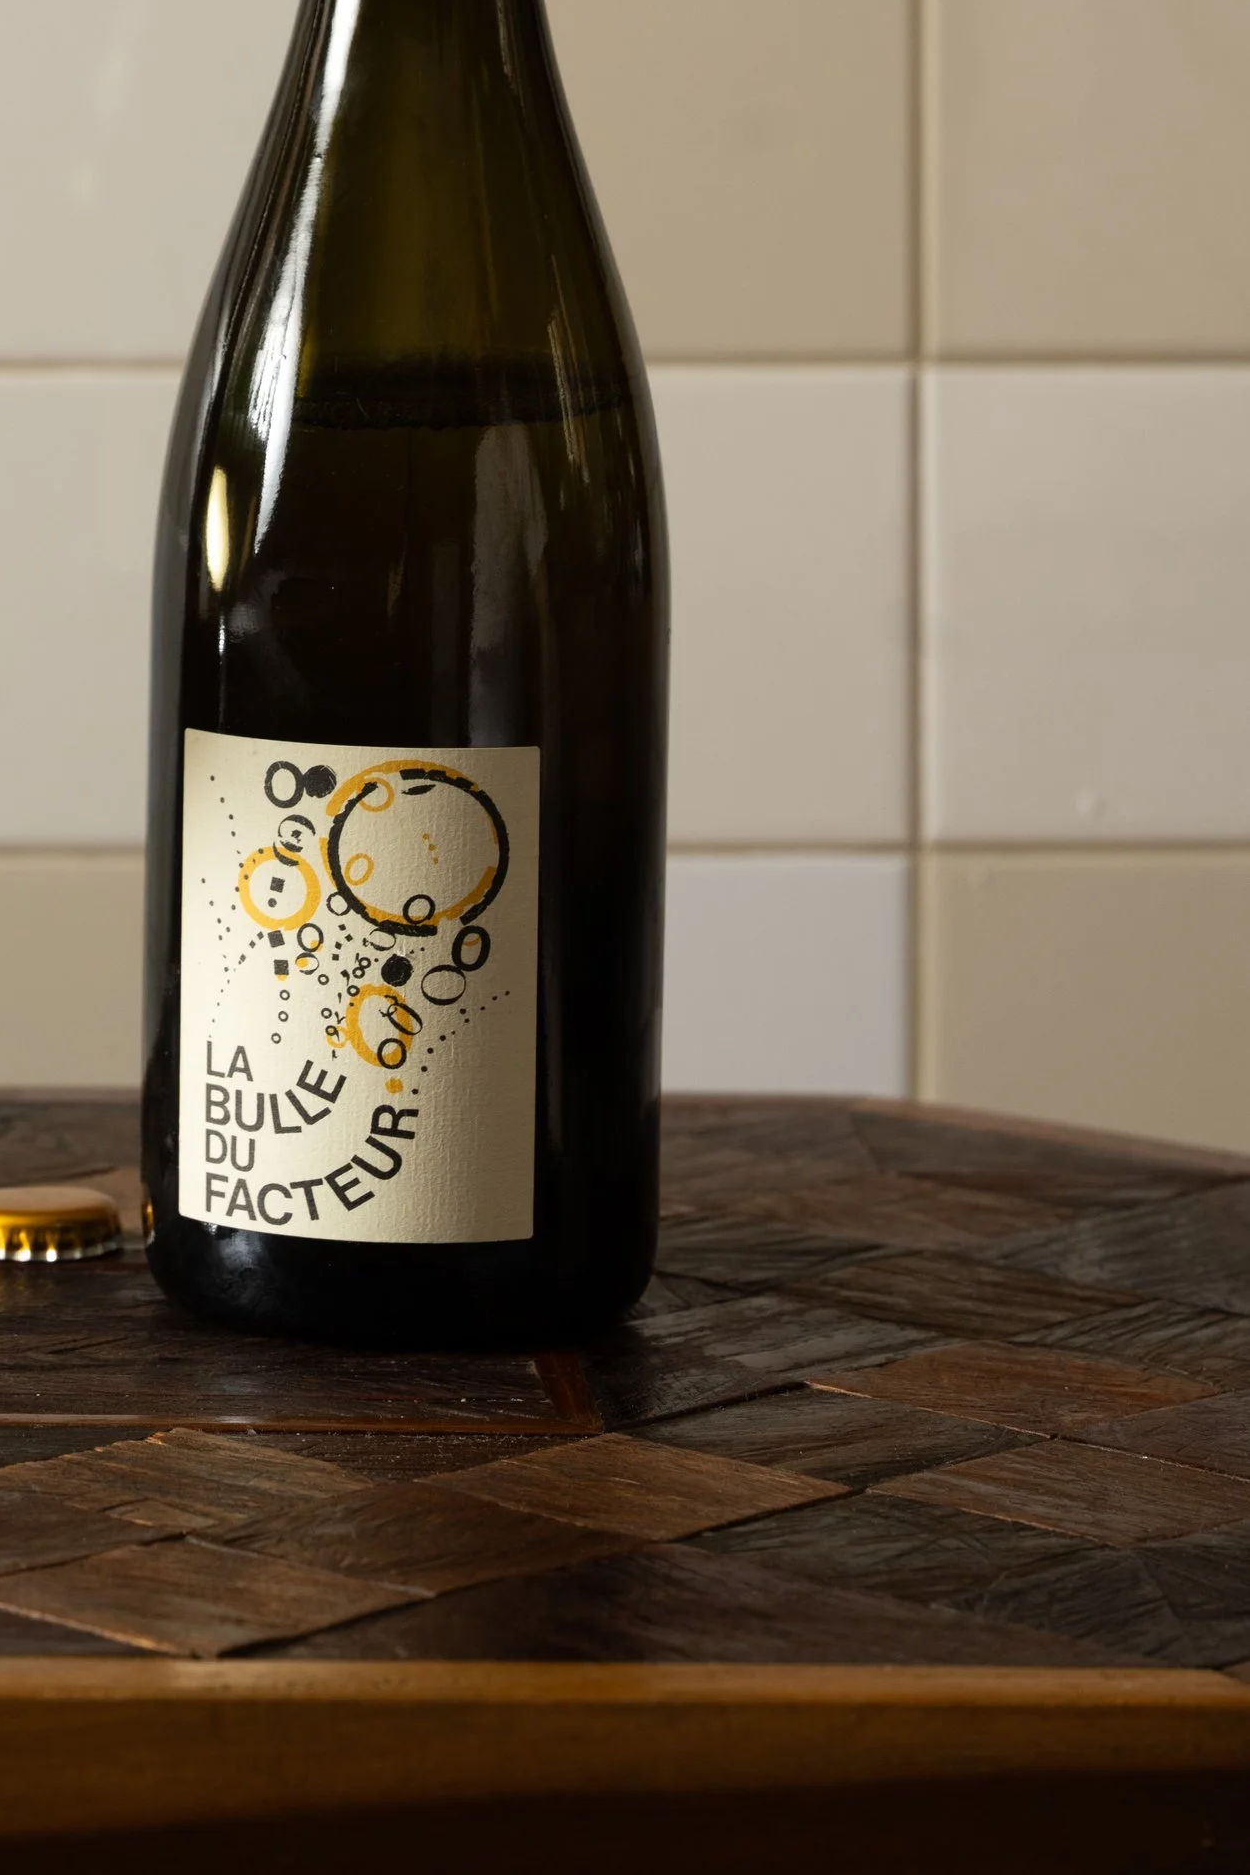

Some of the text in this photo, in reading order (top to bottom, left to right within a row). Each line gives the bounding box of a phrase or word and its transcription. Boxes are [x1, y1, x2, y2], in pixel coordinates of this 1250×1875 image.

[206, 1040, 253, 1082] LA
[205, 1060, 347, 1134] BULLE
[205, 1129, 256, 1172] DU
[205, 1104, 419, 1226] FACTEUR
